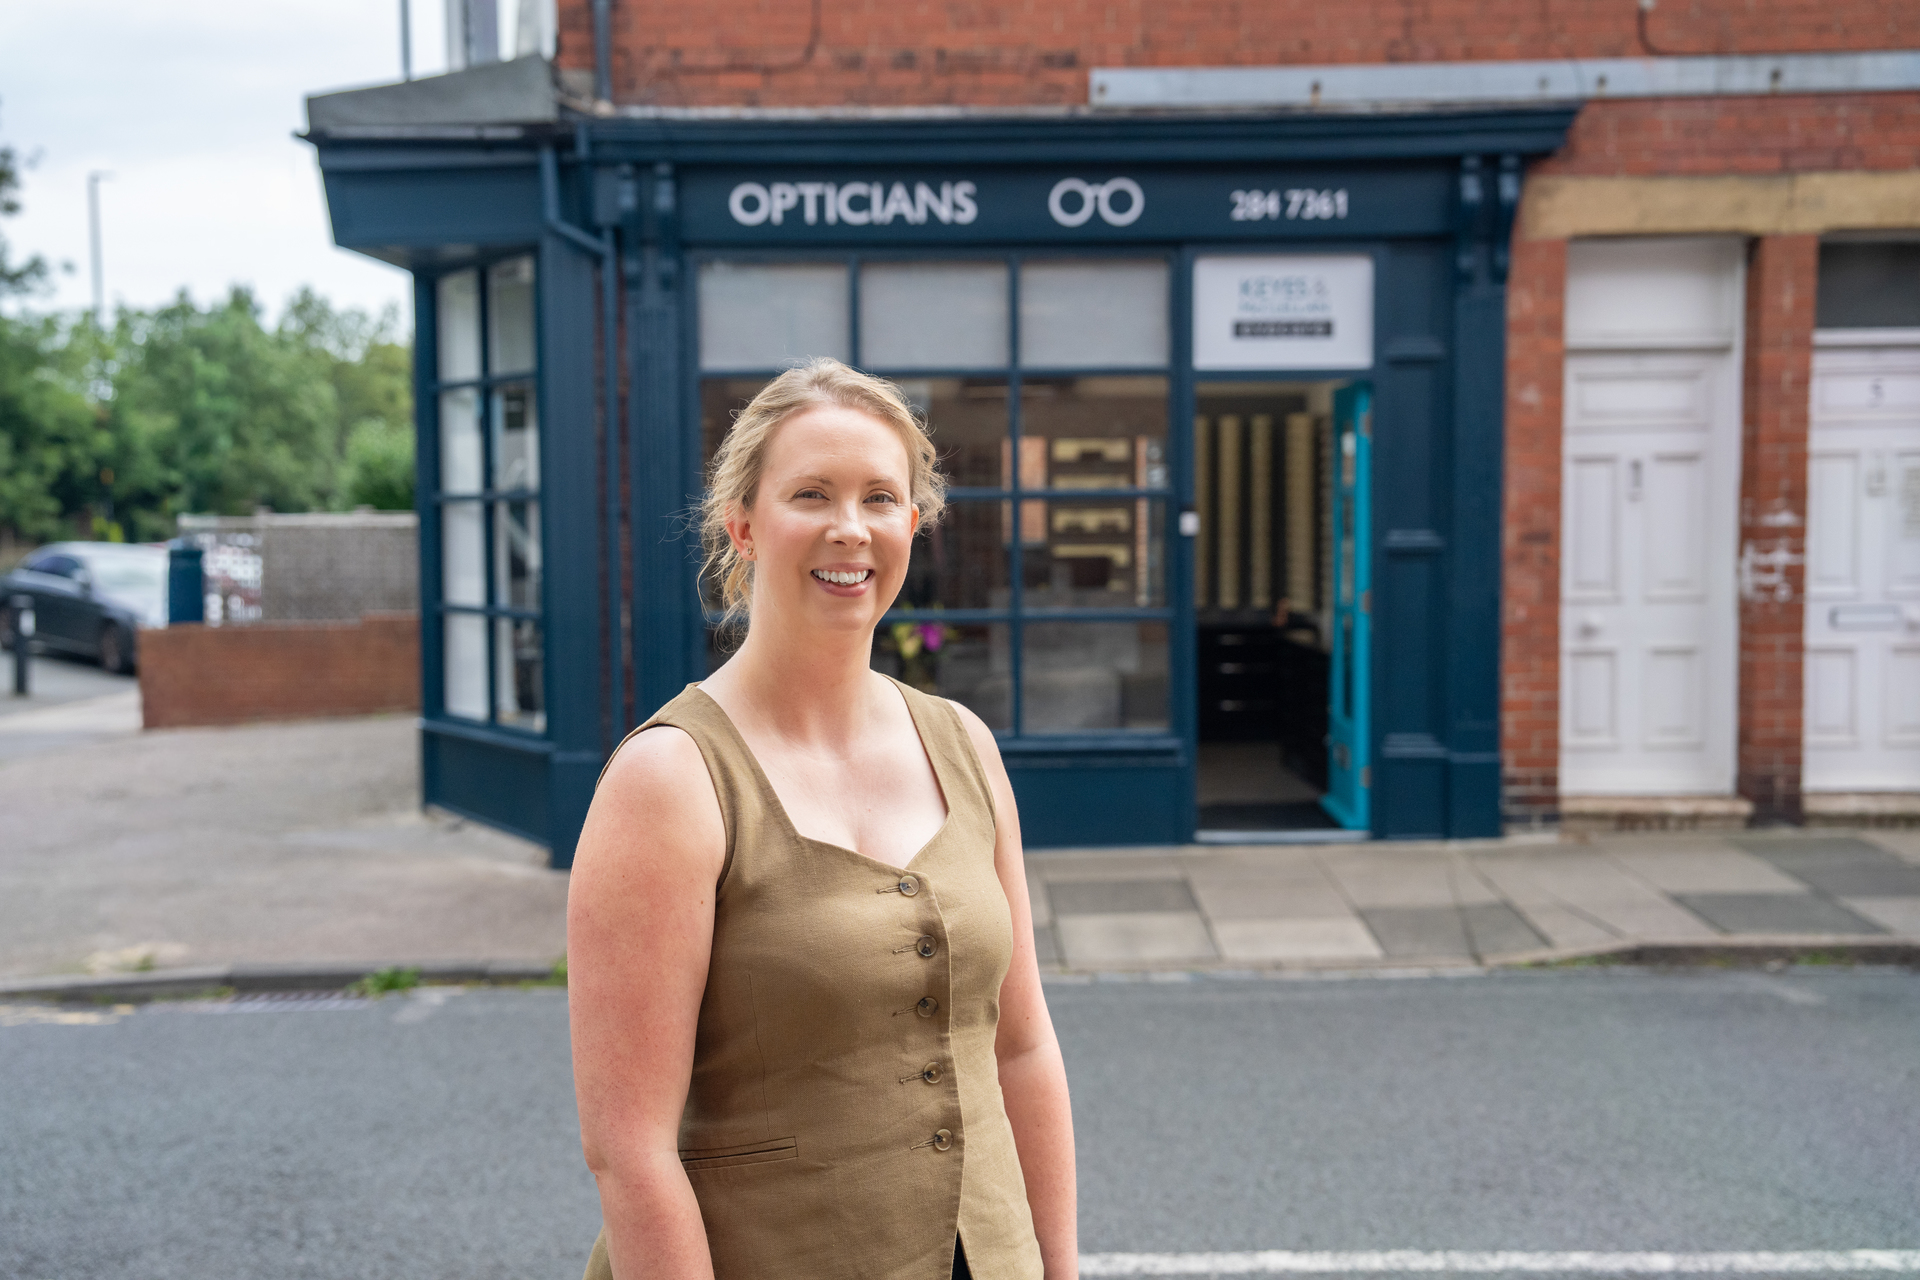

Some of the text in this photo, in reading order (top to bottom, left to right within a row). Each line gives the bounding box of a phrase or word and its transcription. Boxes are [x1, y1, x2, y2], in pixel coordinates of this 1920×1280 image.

[729, 181, 978, 226] OPTICIANS
[1230, 188, 1349, 220] 284 7361
